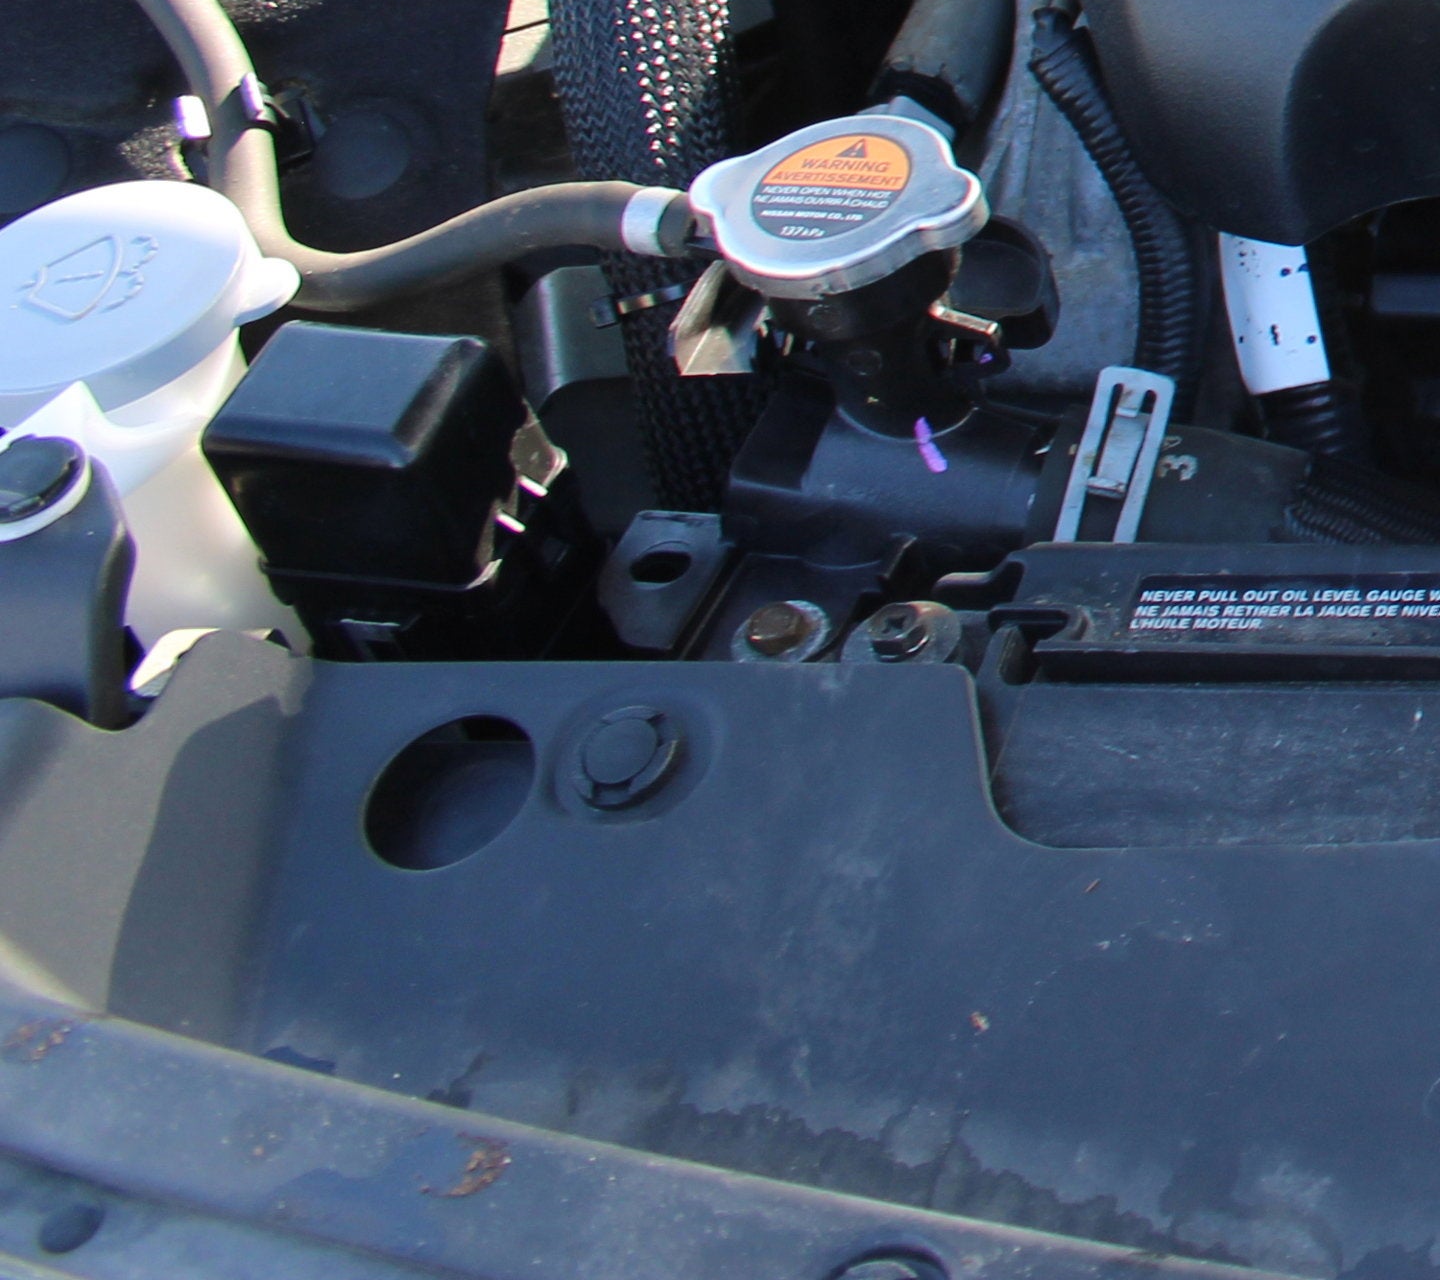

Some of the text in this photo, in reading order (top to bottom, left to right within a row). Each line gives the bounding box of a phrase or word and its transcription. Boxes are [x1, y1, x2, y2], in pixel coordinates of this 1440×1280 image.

[801, 158, 891, 173] WARNING
[772, 171, 904, 186] AVERTISSEMENT
[762, 185, 798, 194] NEVER
[800, 186, 830, 196] OPEN
[832, 188, 866, 197] WHEN
[753, 195, 769, 203] NE
[767, 195, 803, 205] JAMAIS
[804, 196, 843, 206] OUVRIR
[795, 211, 828, 219] MOTOR
[1140, 590, 1194, 603] NEVER
[1197, 590, 1238, 602] PULL
[1242, 590, 1278, 602] OUT
[1282, 590, 1309, 602] OIL
[1312, 590, 1362, 602] LEVEL
[1366, 589, 1425, 602] GAUGE
[1134, 605, 1159, 617] NE
[1160, 605, 1221, 617] JAMAIS
[1222, 605, 1291, 617] RETIRER
[1293, 605, 1315, 617] LA
[1317, 605, 1371, 617] JAUGE
[1374, 604, 1398, 617] DE
[1129, 618, 1190, 630] L'HUILE
